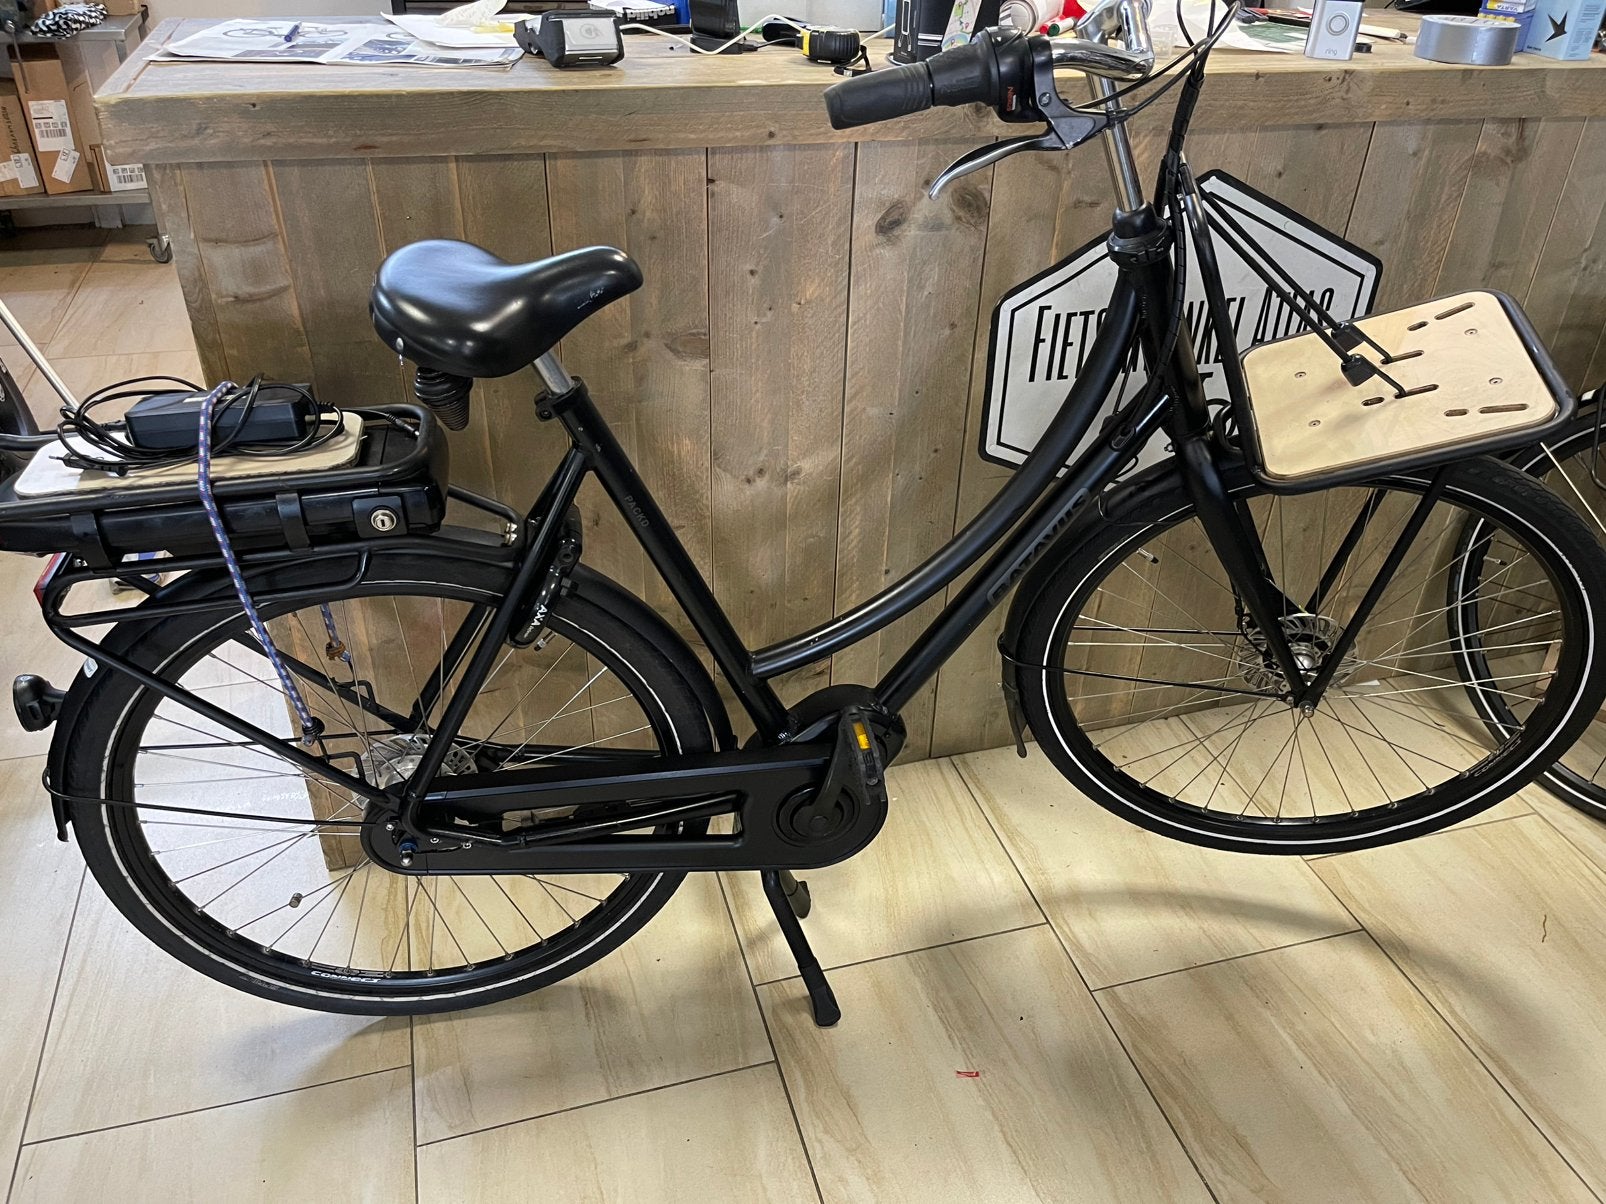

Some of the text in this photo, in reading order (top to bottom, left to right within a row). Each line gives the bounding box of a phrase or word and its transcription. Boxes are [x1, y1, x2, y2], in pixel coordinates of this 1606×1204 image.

[1325, 48, 1338, 56] ring
[624, 495, 649, 527] PACKD
[992, 494, 1084, 602] BATAVUS
[531, 604, 548, 625] AXA
